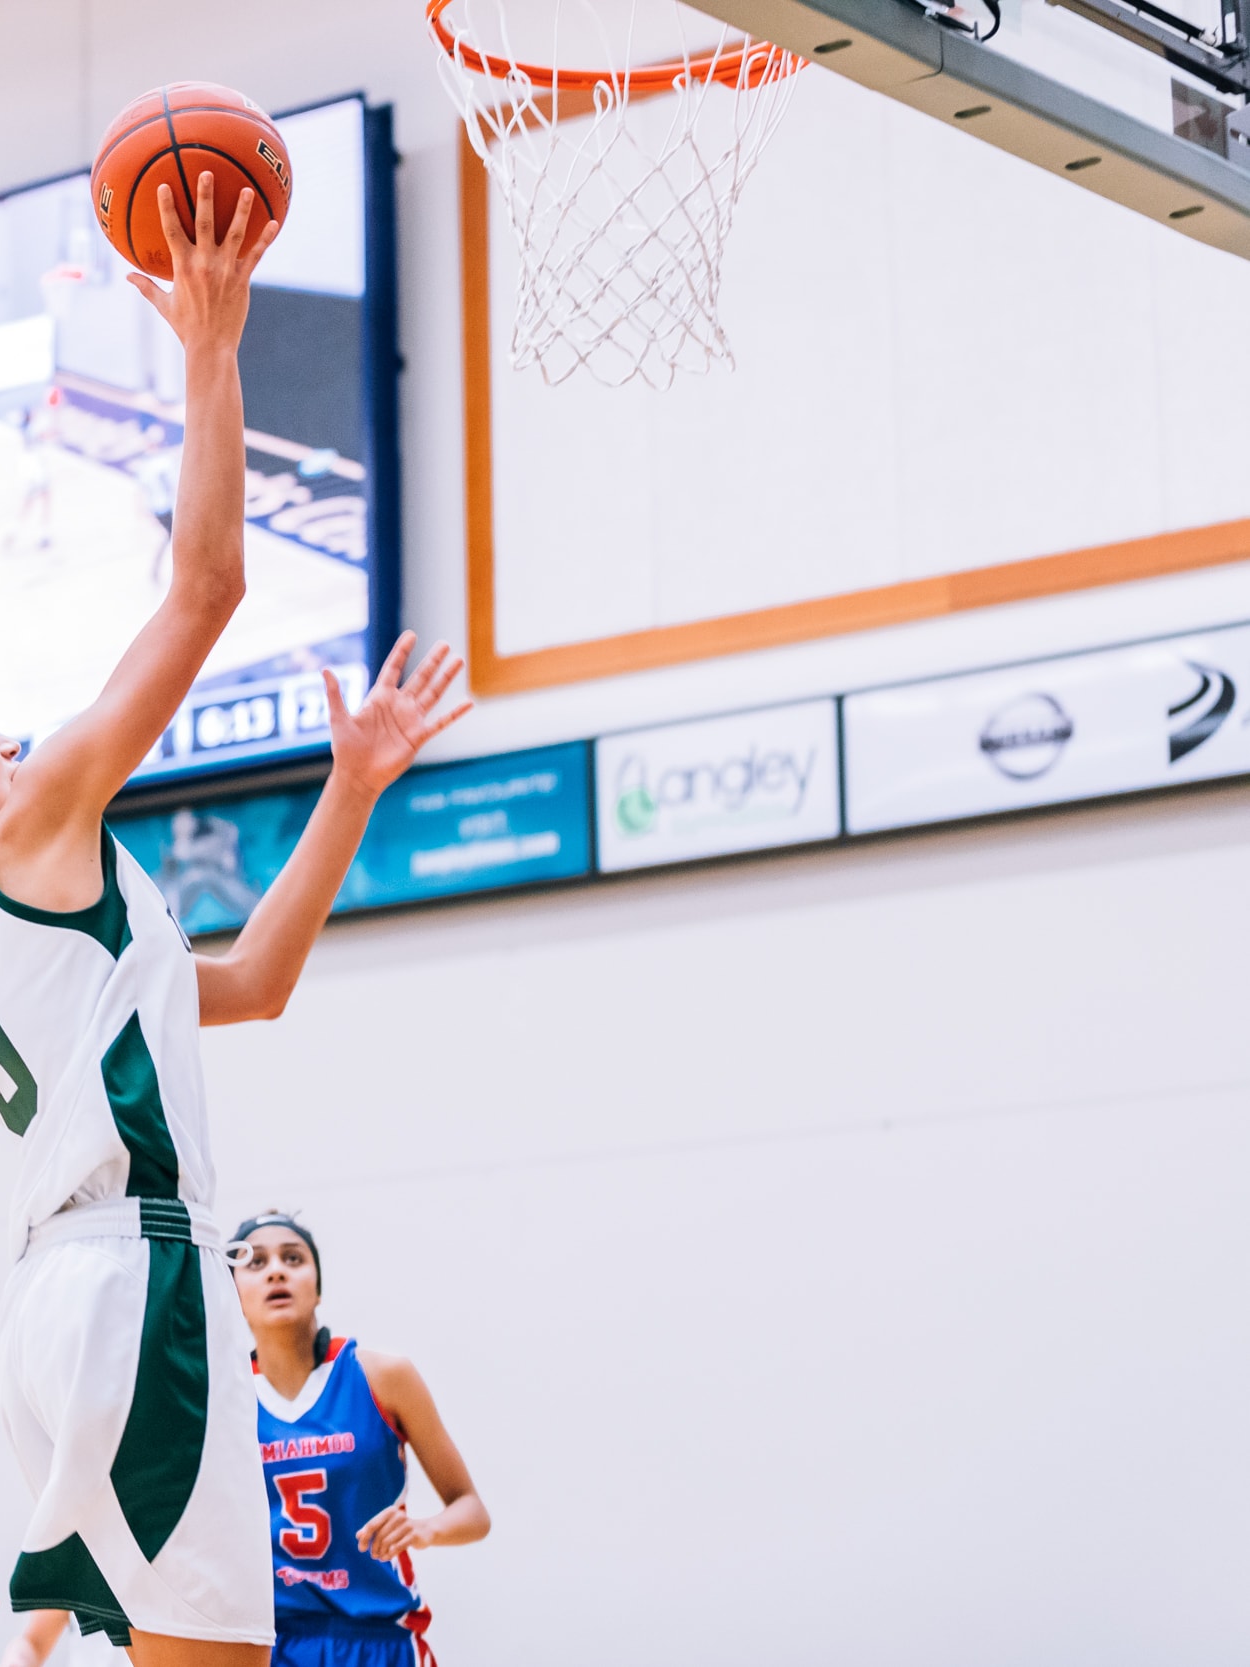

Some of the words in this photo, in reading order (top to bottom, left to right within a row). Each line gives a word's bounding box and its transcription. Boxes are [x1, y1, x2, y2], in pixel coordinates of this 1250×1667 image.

[256, 139, 291, 192] ELI
[258, 1432, 355, 1463] MIAHMOO
[272, 1467, 332, 1560] 5
